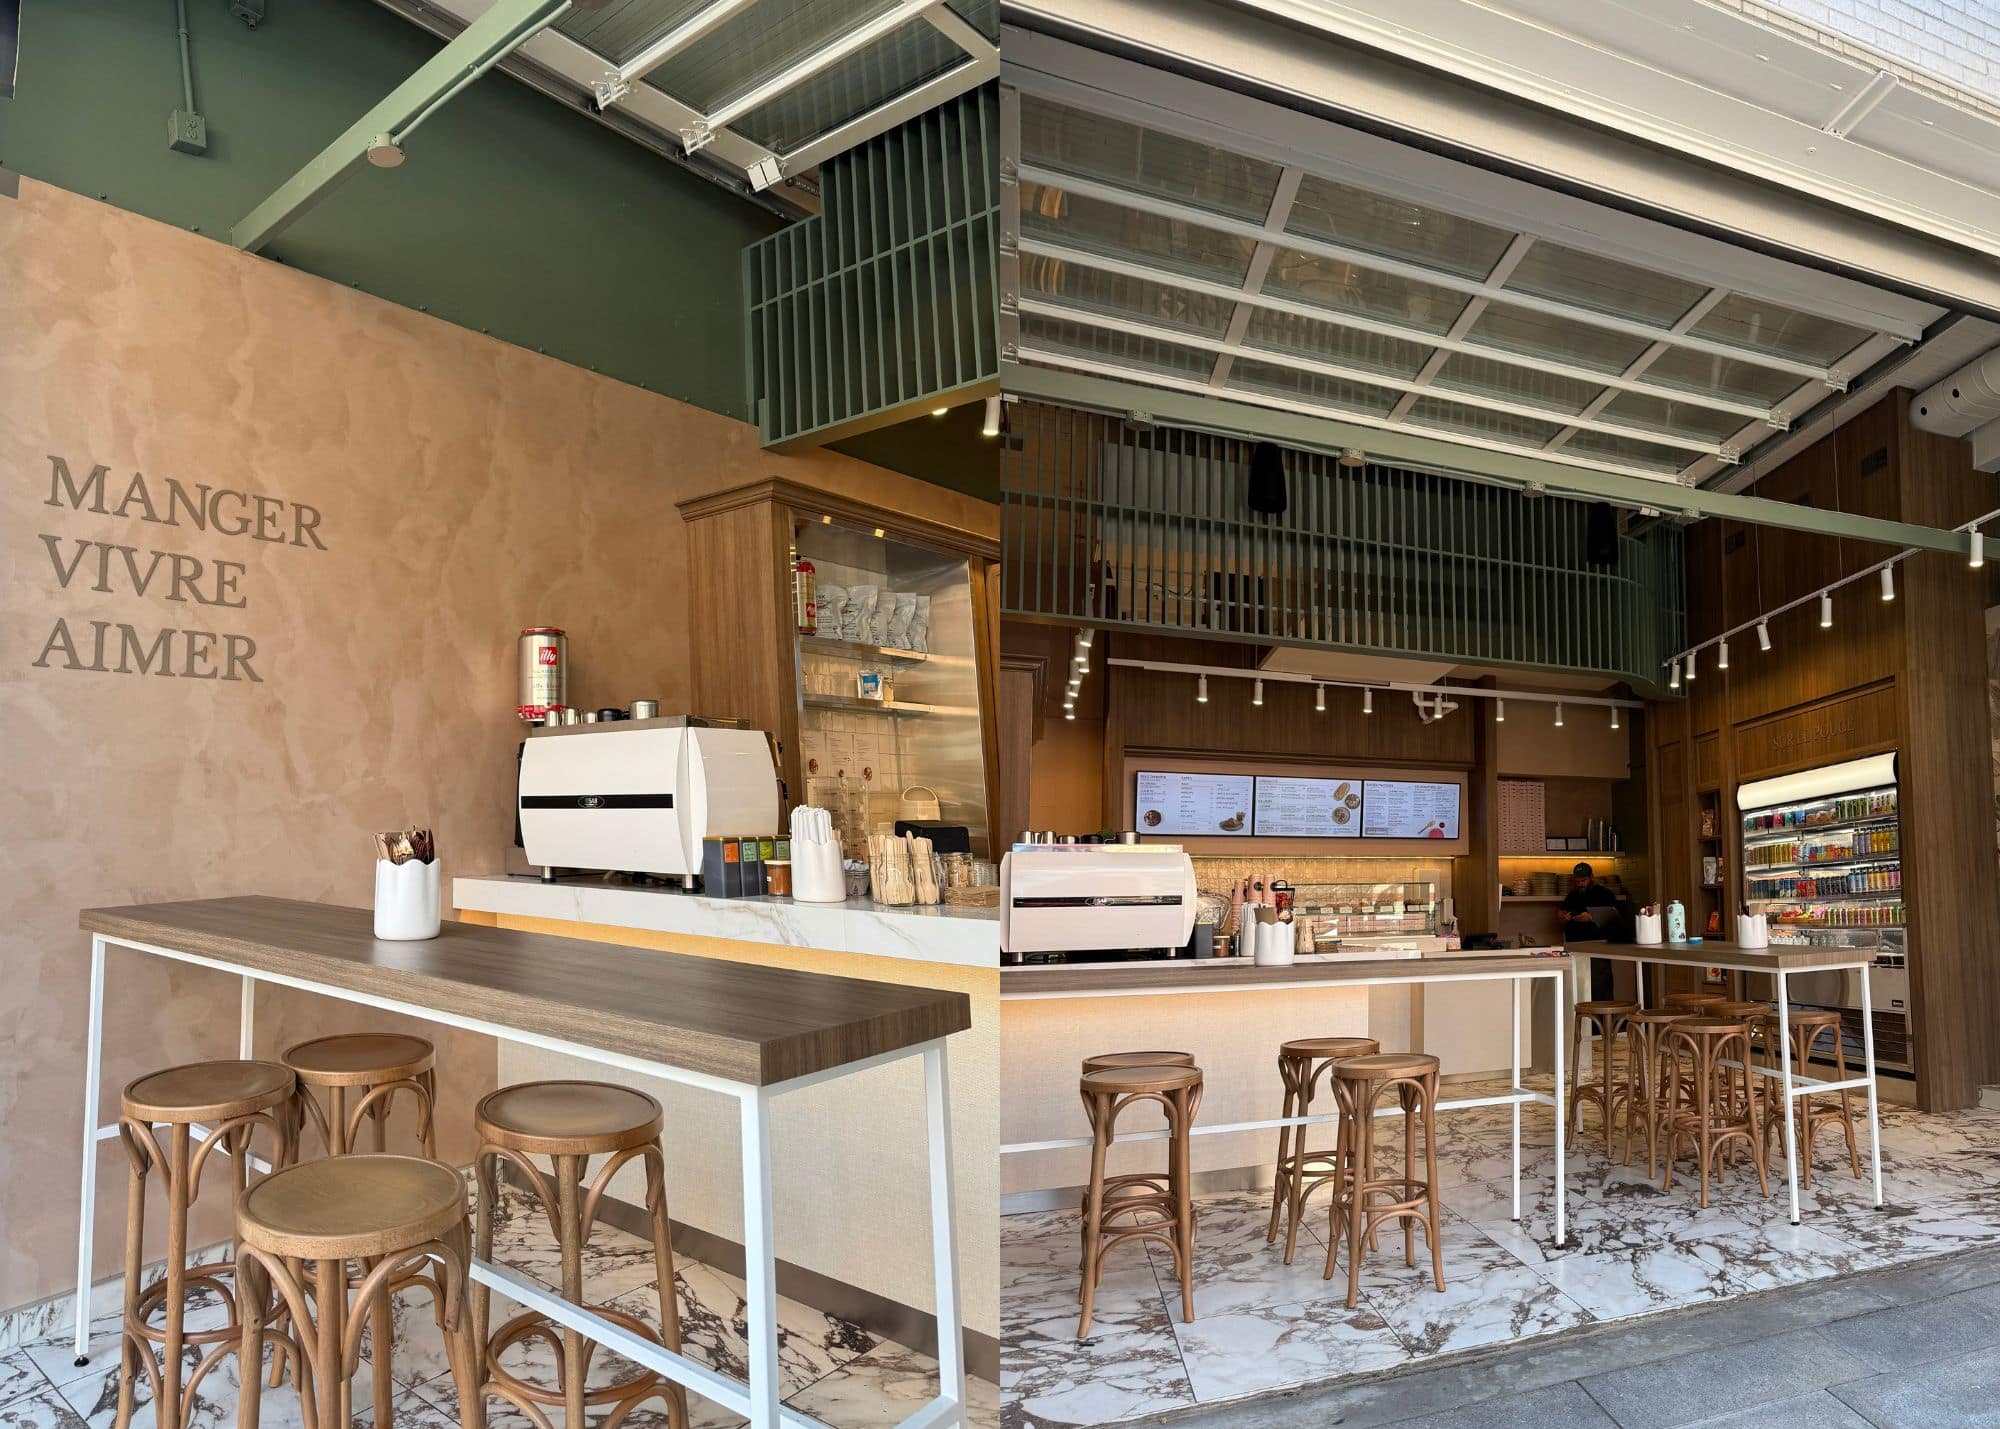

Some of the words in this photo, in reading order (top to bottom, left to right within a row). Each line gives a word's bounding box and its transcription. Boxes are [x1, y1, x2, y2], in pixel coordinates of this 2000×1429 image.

[44, 455, 328, 551] MANGER
[38, 533, 247, 608] VIVRE
[31, 617, 264, 683] AIMER
[540, 648, 557, 664] illy
